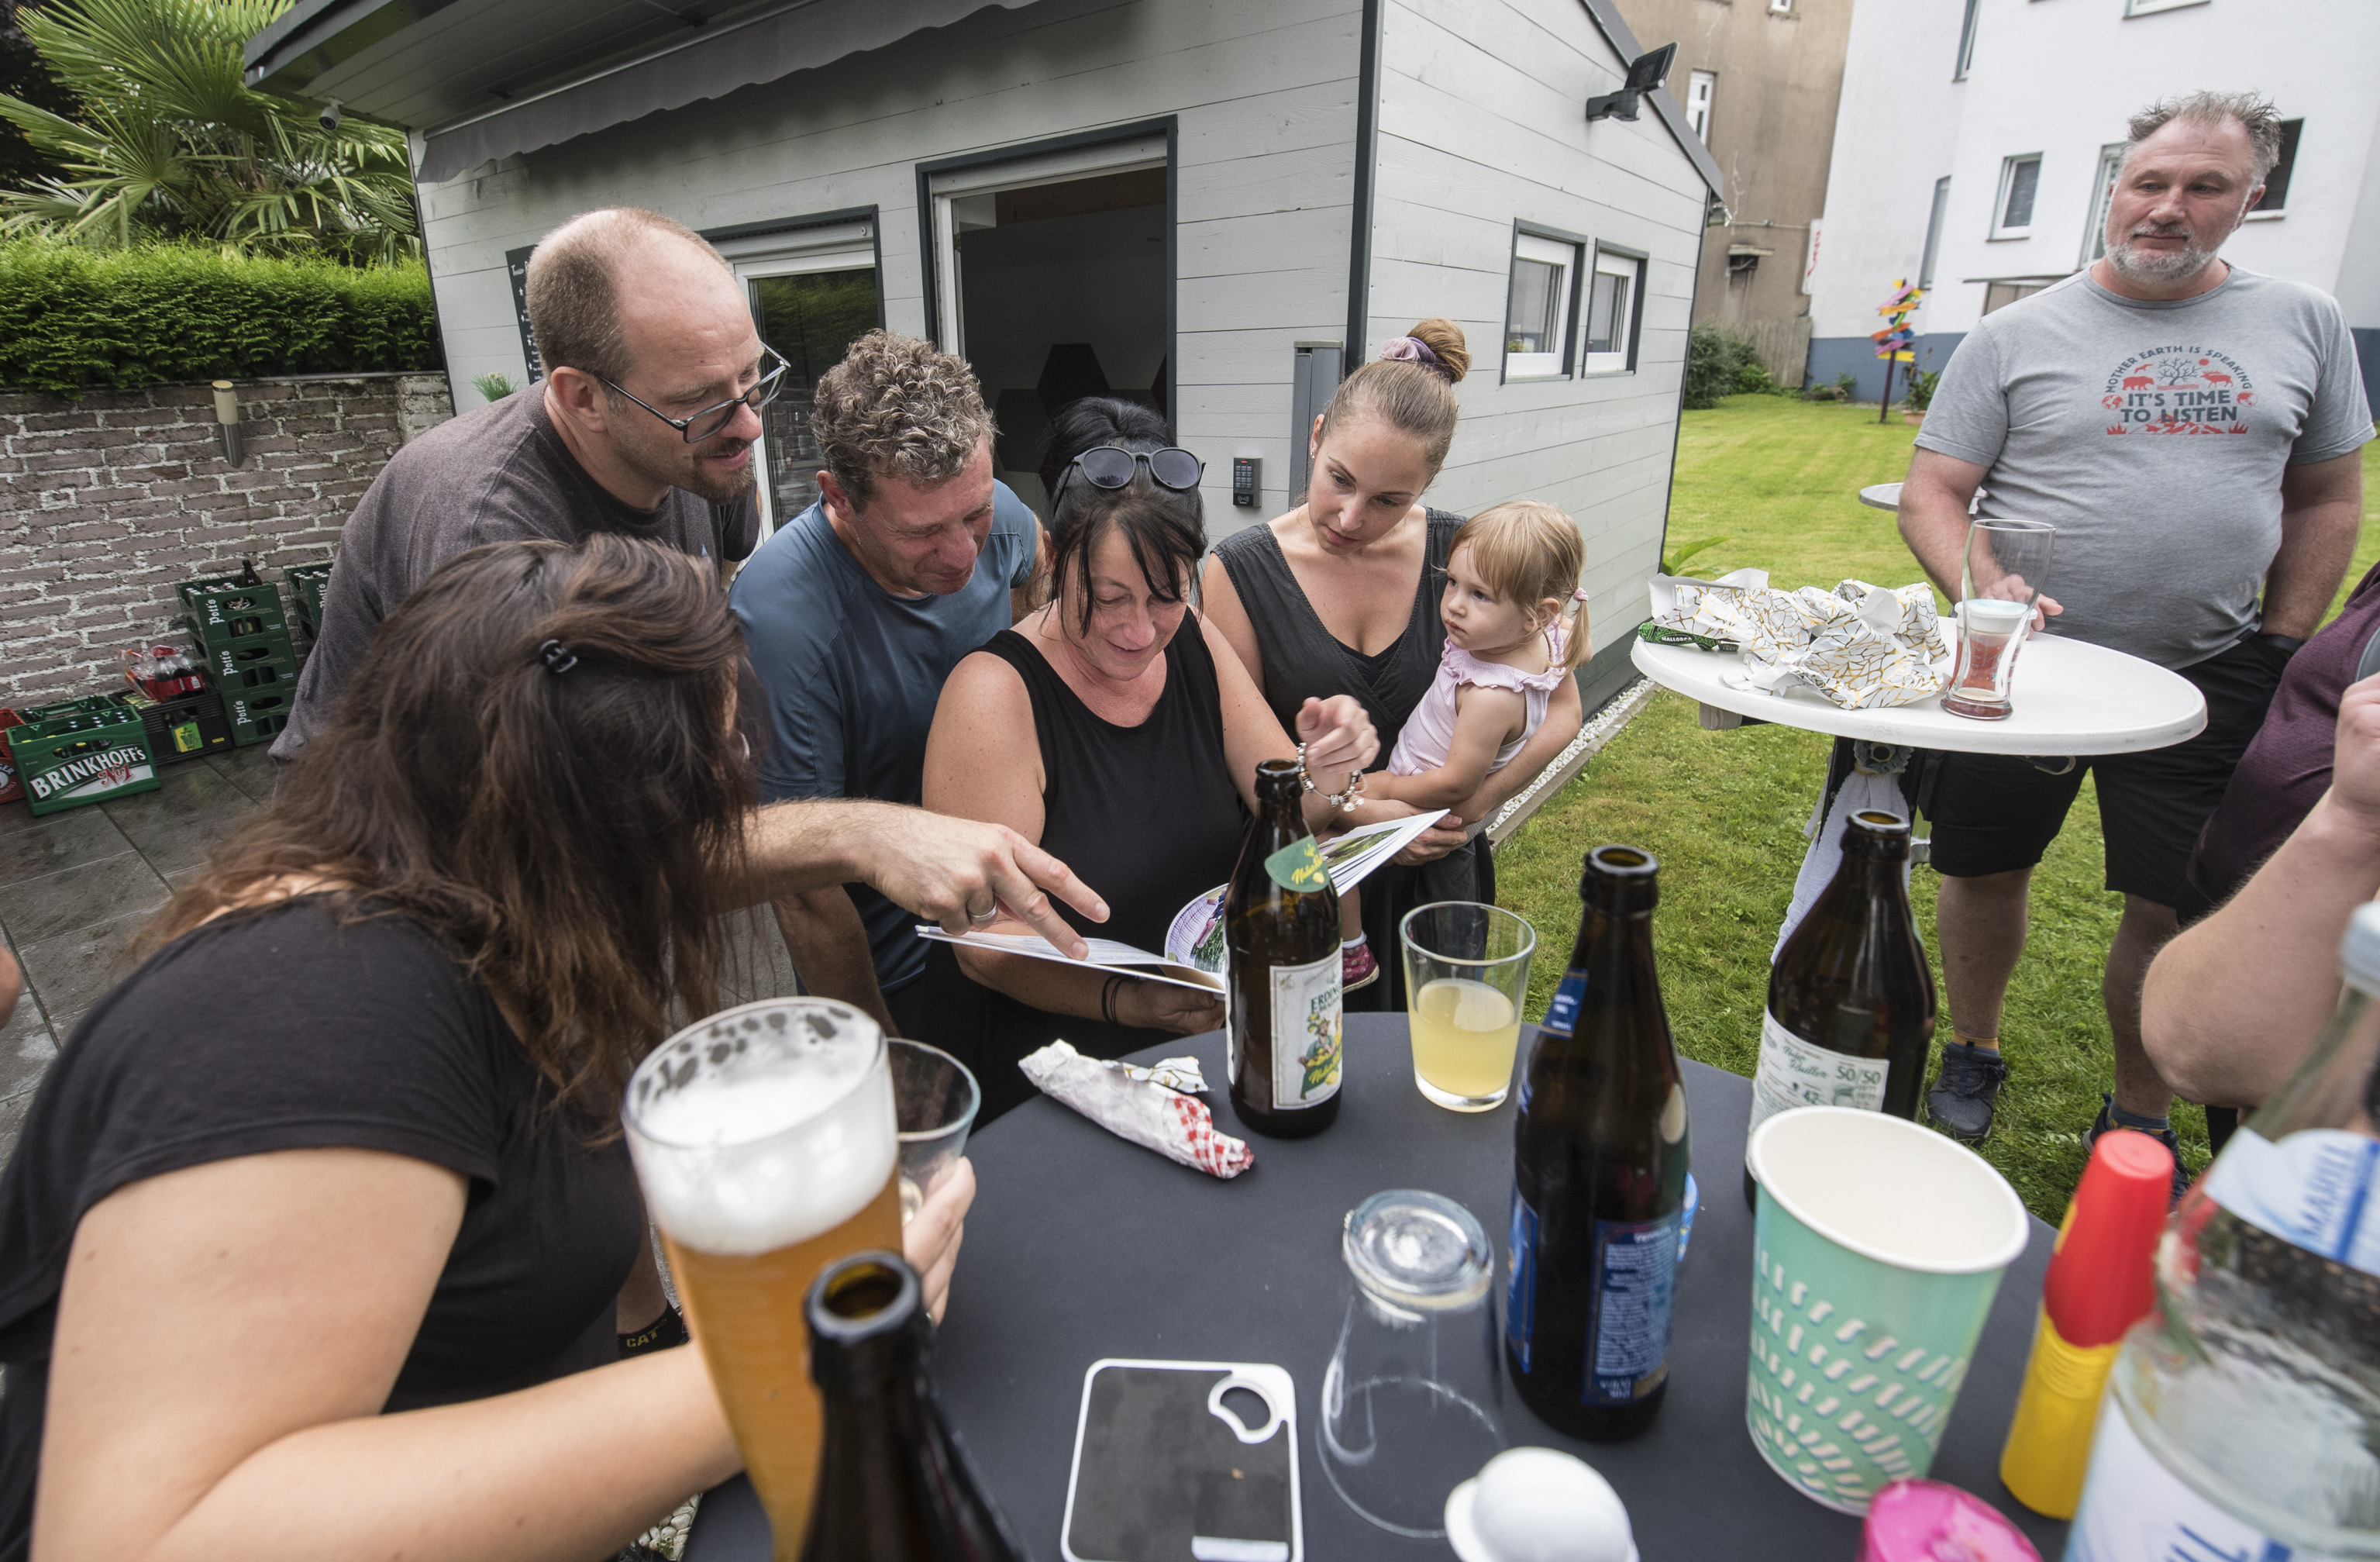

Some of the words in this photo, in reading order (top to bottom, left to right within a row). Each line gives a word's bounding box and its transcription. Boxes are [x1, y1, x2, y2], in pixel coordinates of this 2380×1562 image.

[2106, 357, 2138, 393] MOTHER
[2139, 346, 2183, 360] EARTH
[2205, 350, 2253, 389] SPEAKING
[2128, 393, 2165, 407] IT'S
[2174, 390, 2231, 406] TIME
[2120, 409, 2151, 423] TO
[2161, 406, 2238, 423] LISTEN
[626, 1326, 659, 1347] CAT
